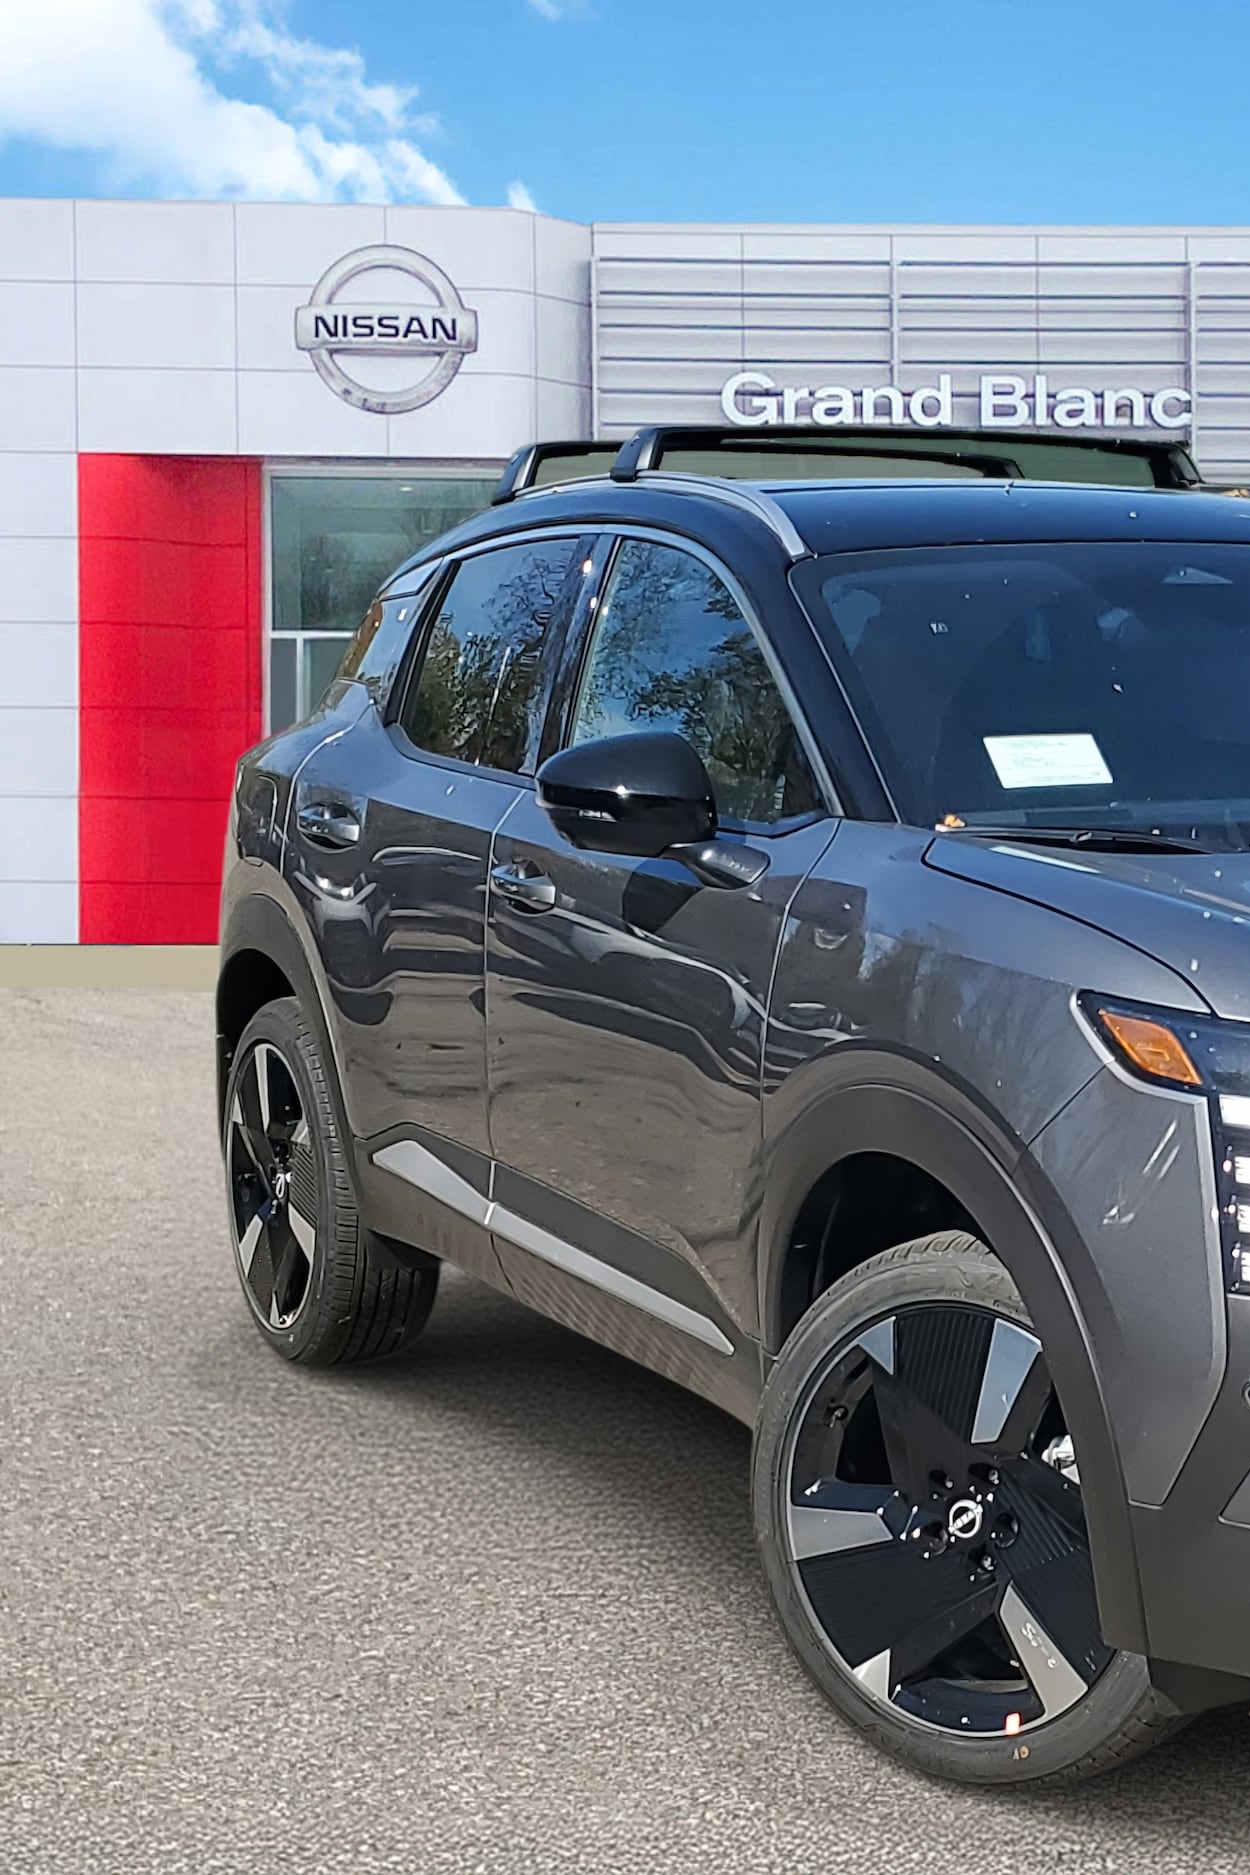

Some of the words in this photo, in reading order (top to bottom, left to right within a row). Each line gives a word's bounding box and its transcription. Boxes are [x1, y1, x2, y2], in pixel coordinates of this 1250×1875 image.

[314, 314, 457, 341] NISSAN
[720, 372, 951, 427] Grand
[979, 374, 1193, 428] Blanc
